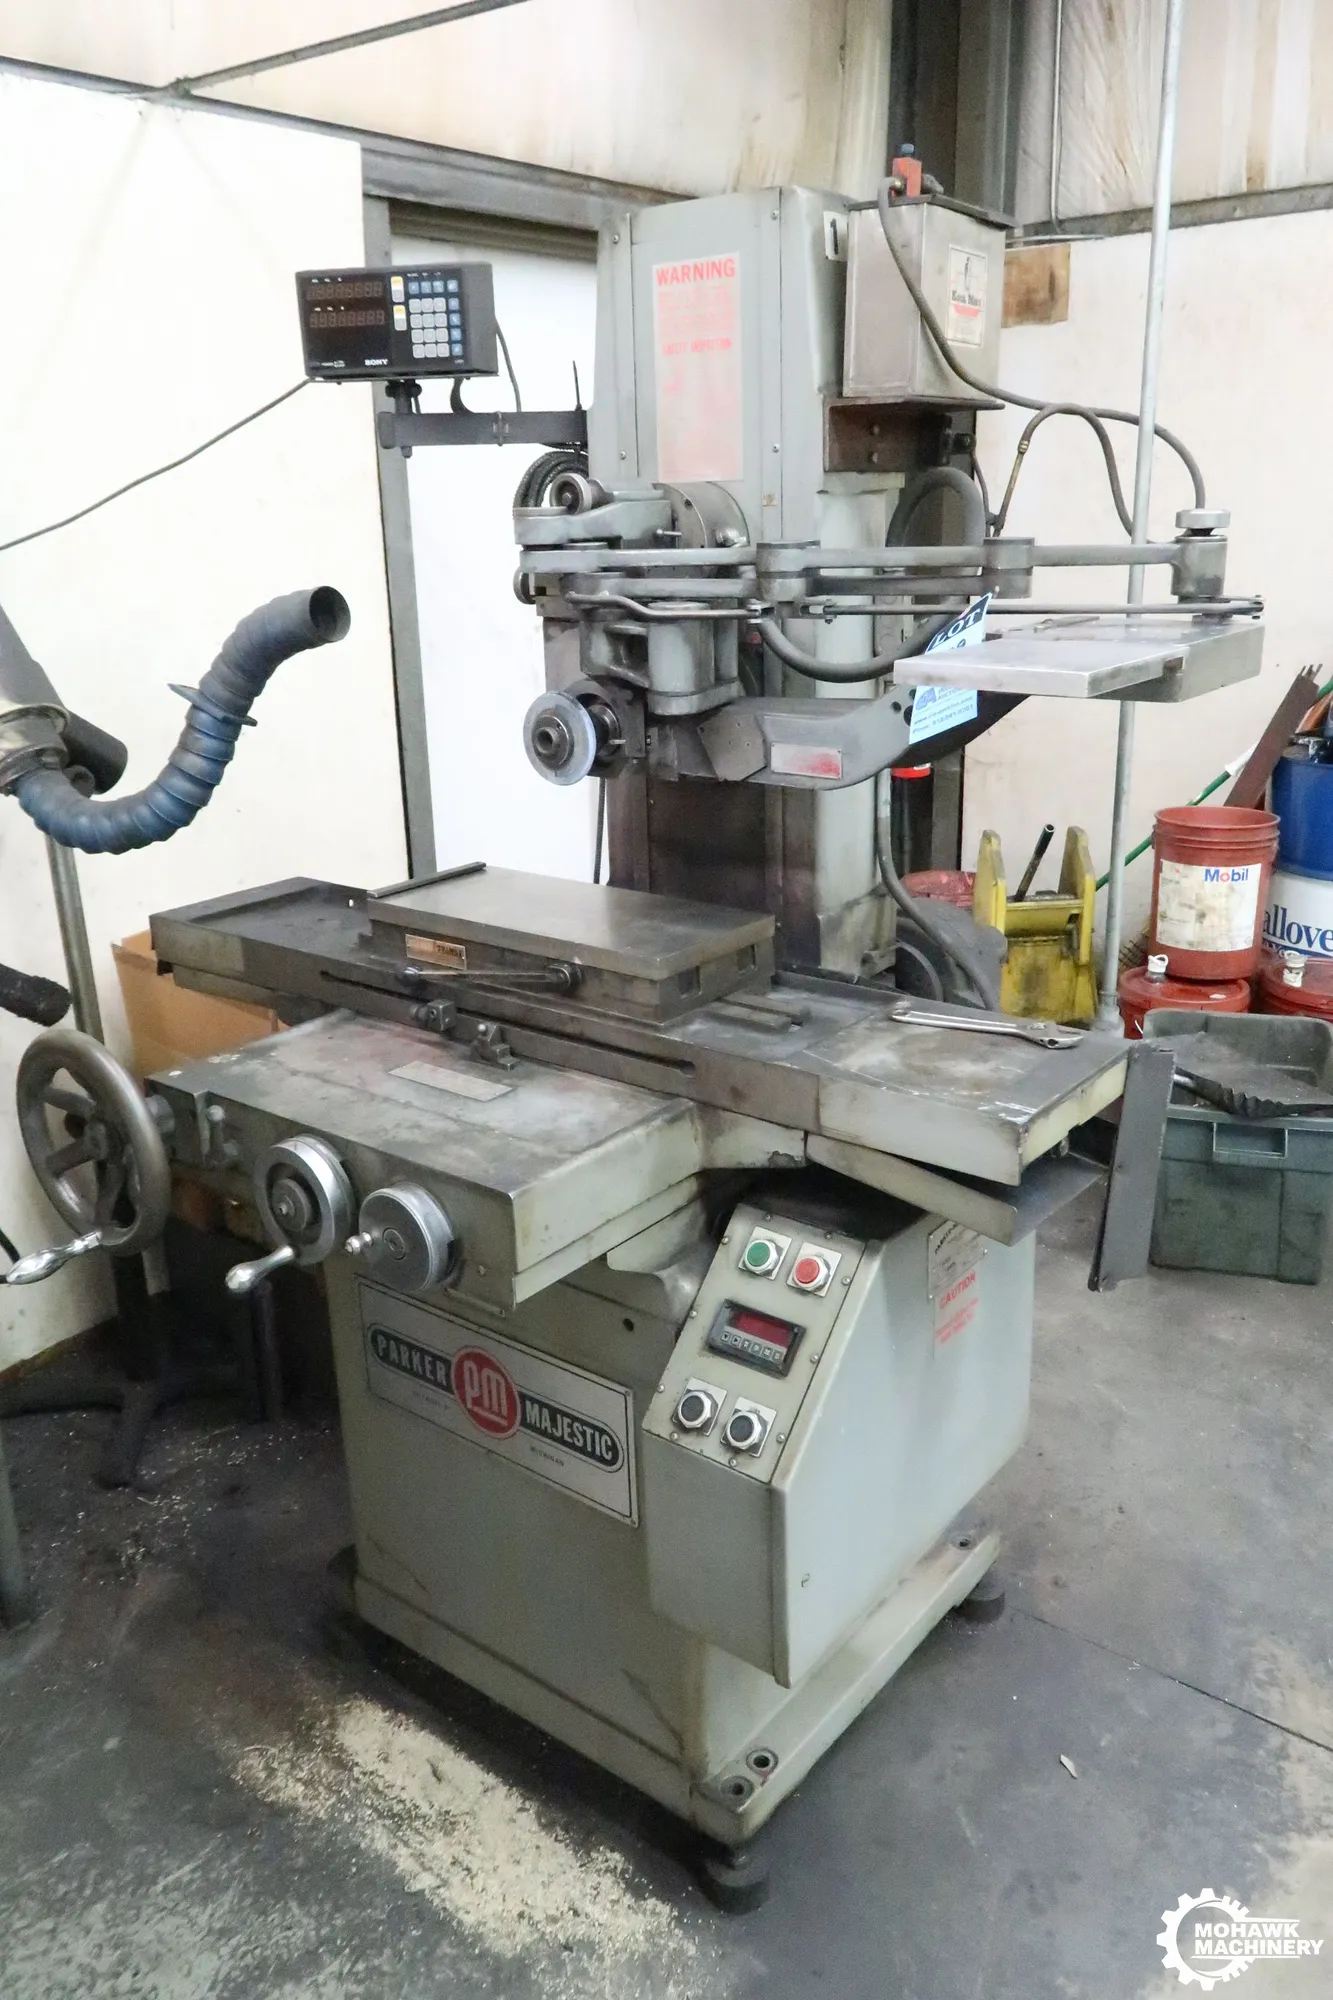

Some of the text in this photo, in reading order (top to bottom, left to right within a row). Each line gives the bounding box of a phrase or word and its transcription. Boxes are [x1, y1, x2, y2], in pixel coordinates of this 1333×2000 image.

[656, 258, 736, 286] WARNING
[364, 358, 388, 366] SONY
[932, 608, 981, 648] LOT
[1204, 868, 1249, 883] Mobil
[940, 1271, 976, 1309] CAUTION
[376, 1334, 447, 1388] PARKER
[525, 1400, 613, 1461] MAJESTIC
